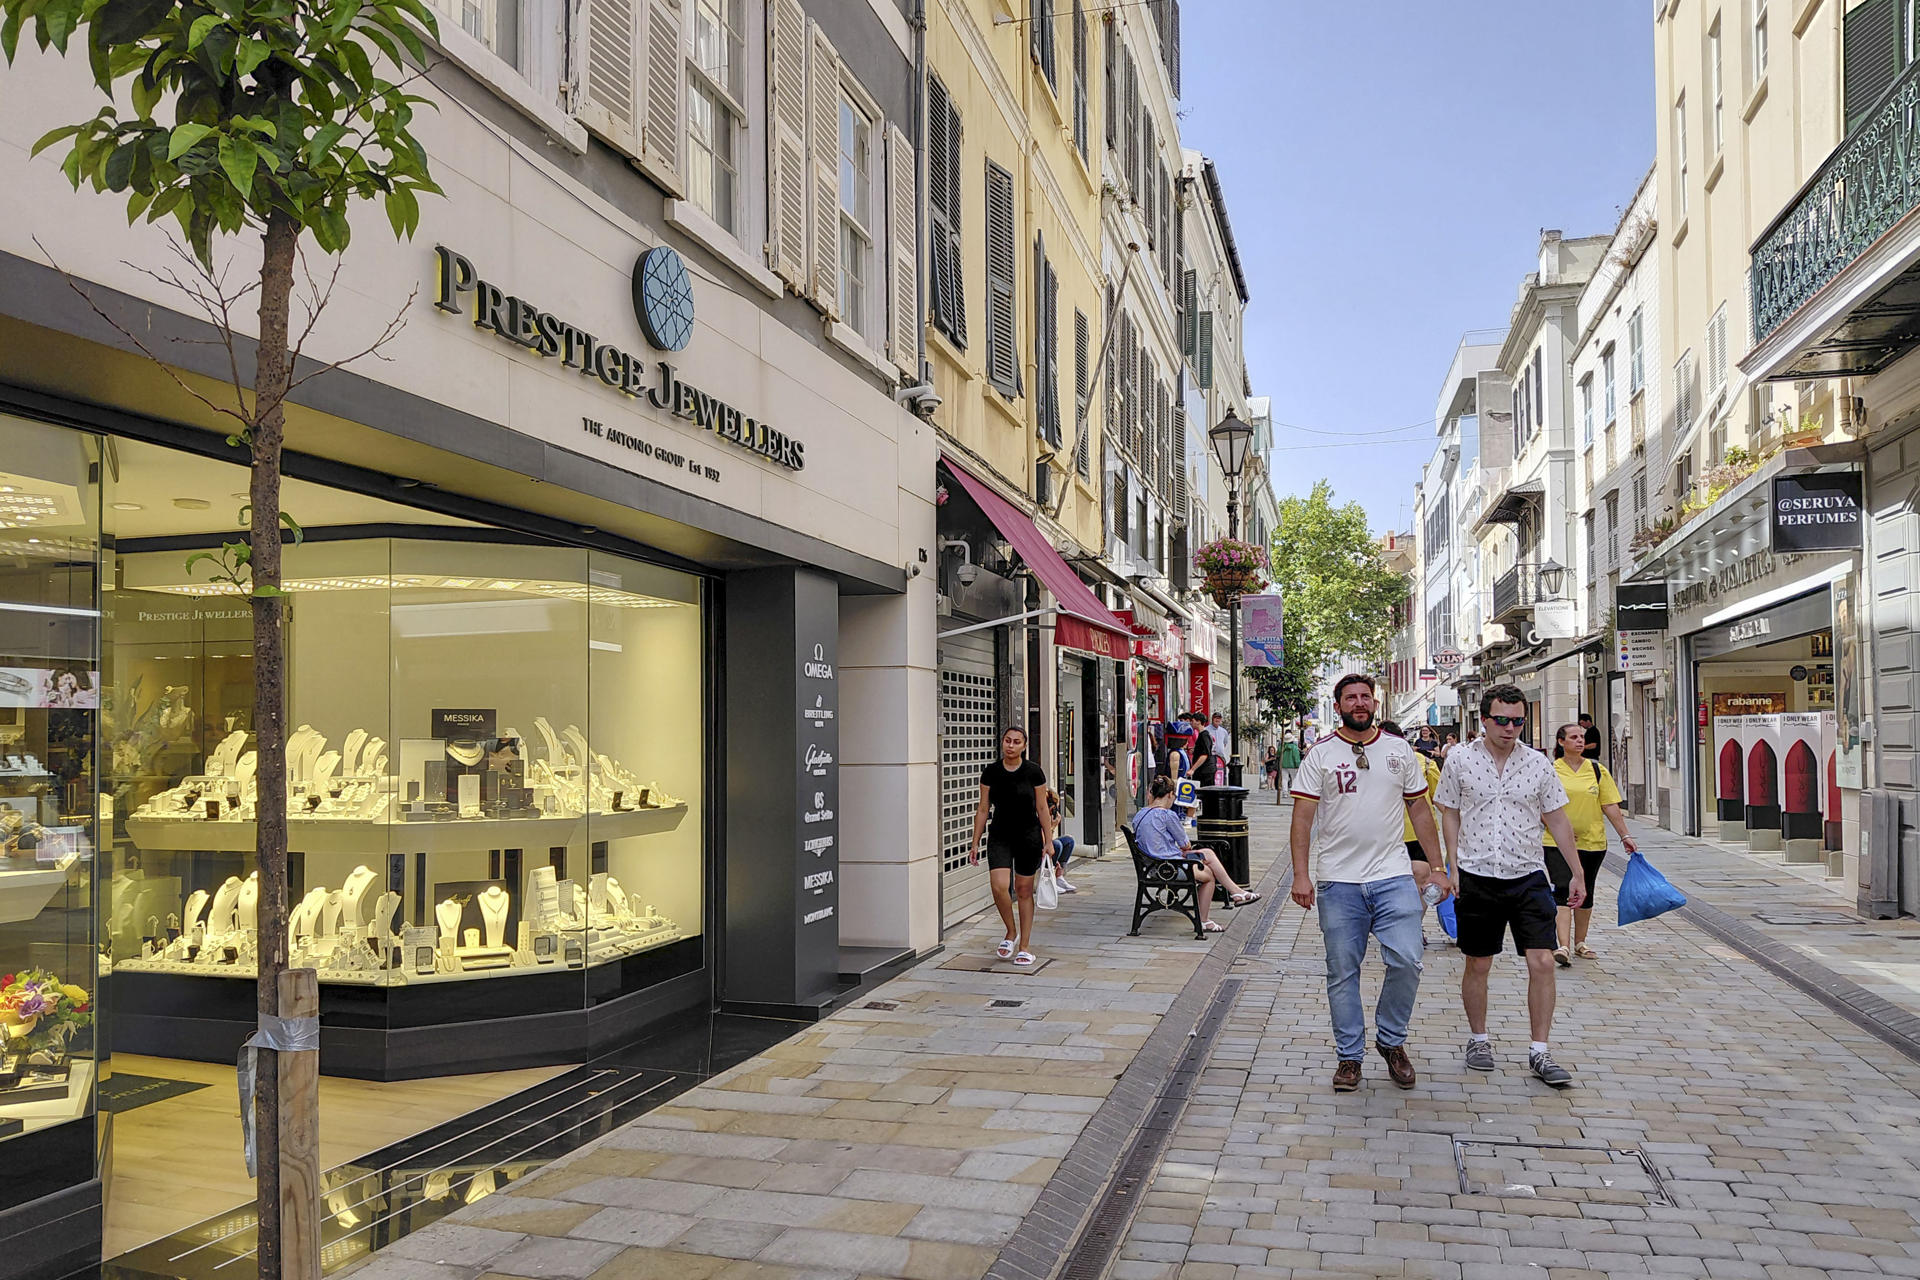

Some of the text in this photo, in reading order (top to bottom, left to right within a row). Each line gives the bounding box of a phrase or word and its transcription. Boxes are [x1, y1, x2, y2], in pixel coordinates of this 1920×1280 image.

[434, 244, 805, 471] PRESTIGE JEWELLERS
[582, 417, 604, 437] THE
[606, 427, 653, 456] ANTONIO
[655, 446, 686, 468] GROUP
[1778, 496, 1857, 512] @SERUYA
[1778, 511, 1858, 526] PERFUMES
[138, 608, 254, 622] PRESTIGE JEWELLERS
[1618, 603, 1668, 611] MAC
[1433, 654, 1464, 664] VIJAY
[804, 662, 833, 680] OMEGA
[1194, 675, 1204, 714] ATALAN
[1727, 697, 1773, 706] rabanne
[443, 713, 486, 723] MESSIKA
[1336, 771, 1357, 794] 12
[804, 870, 834, 890] MESSIKA
